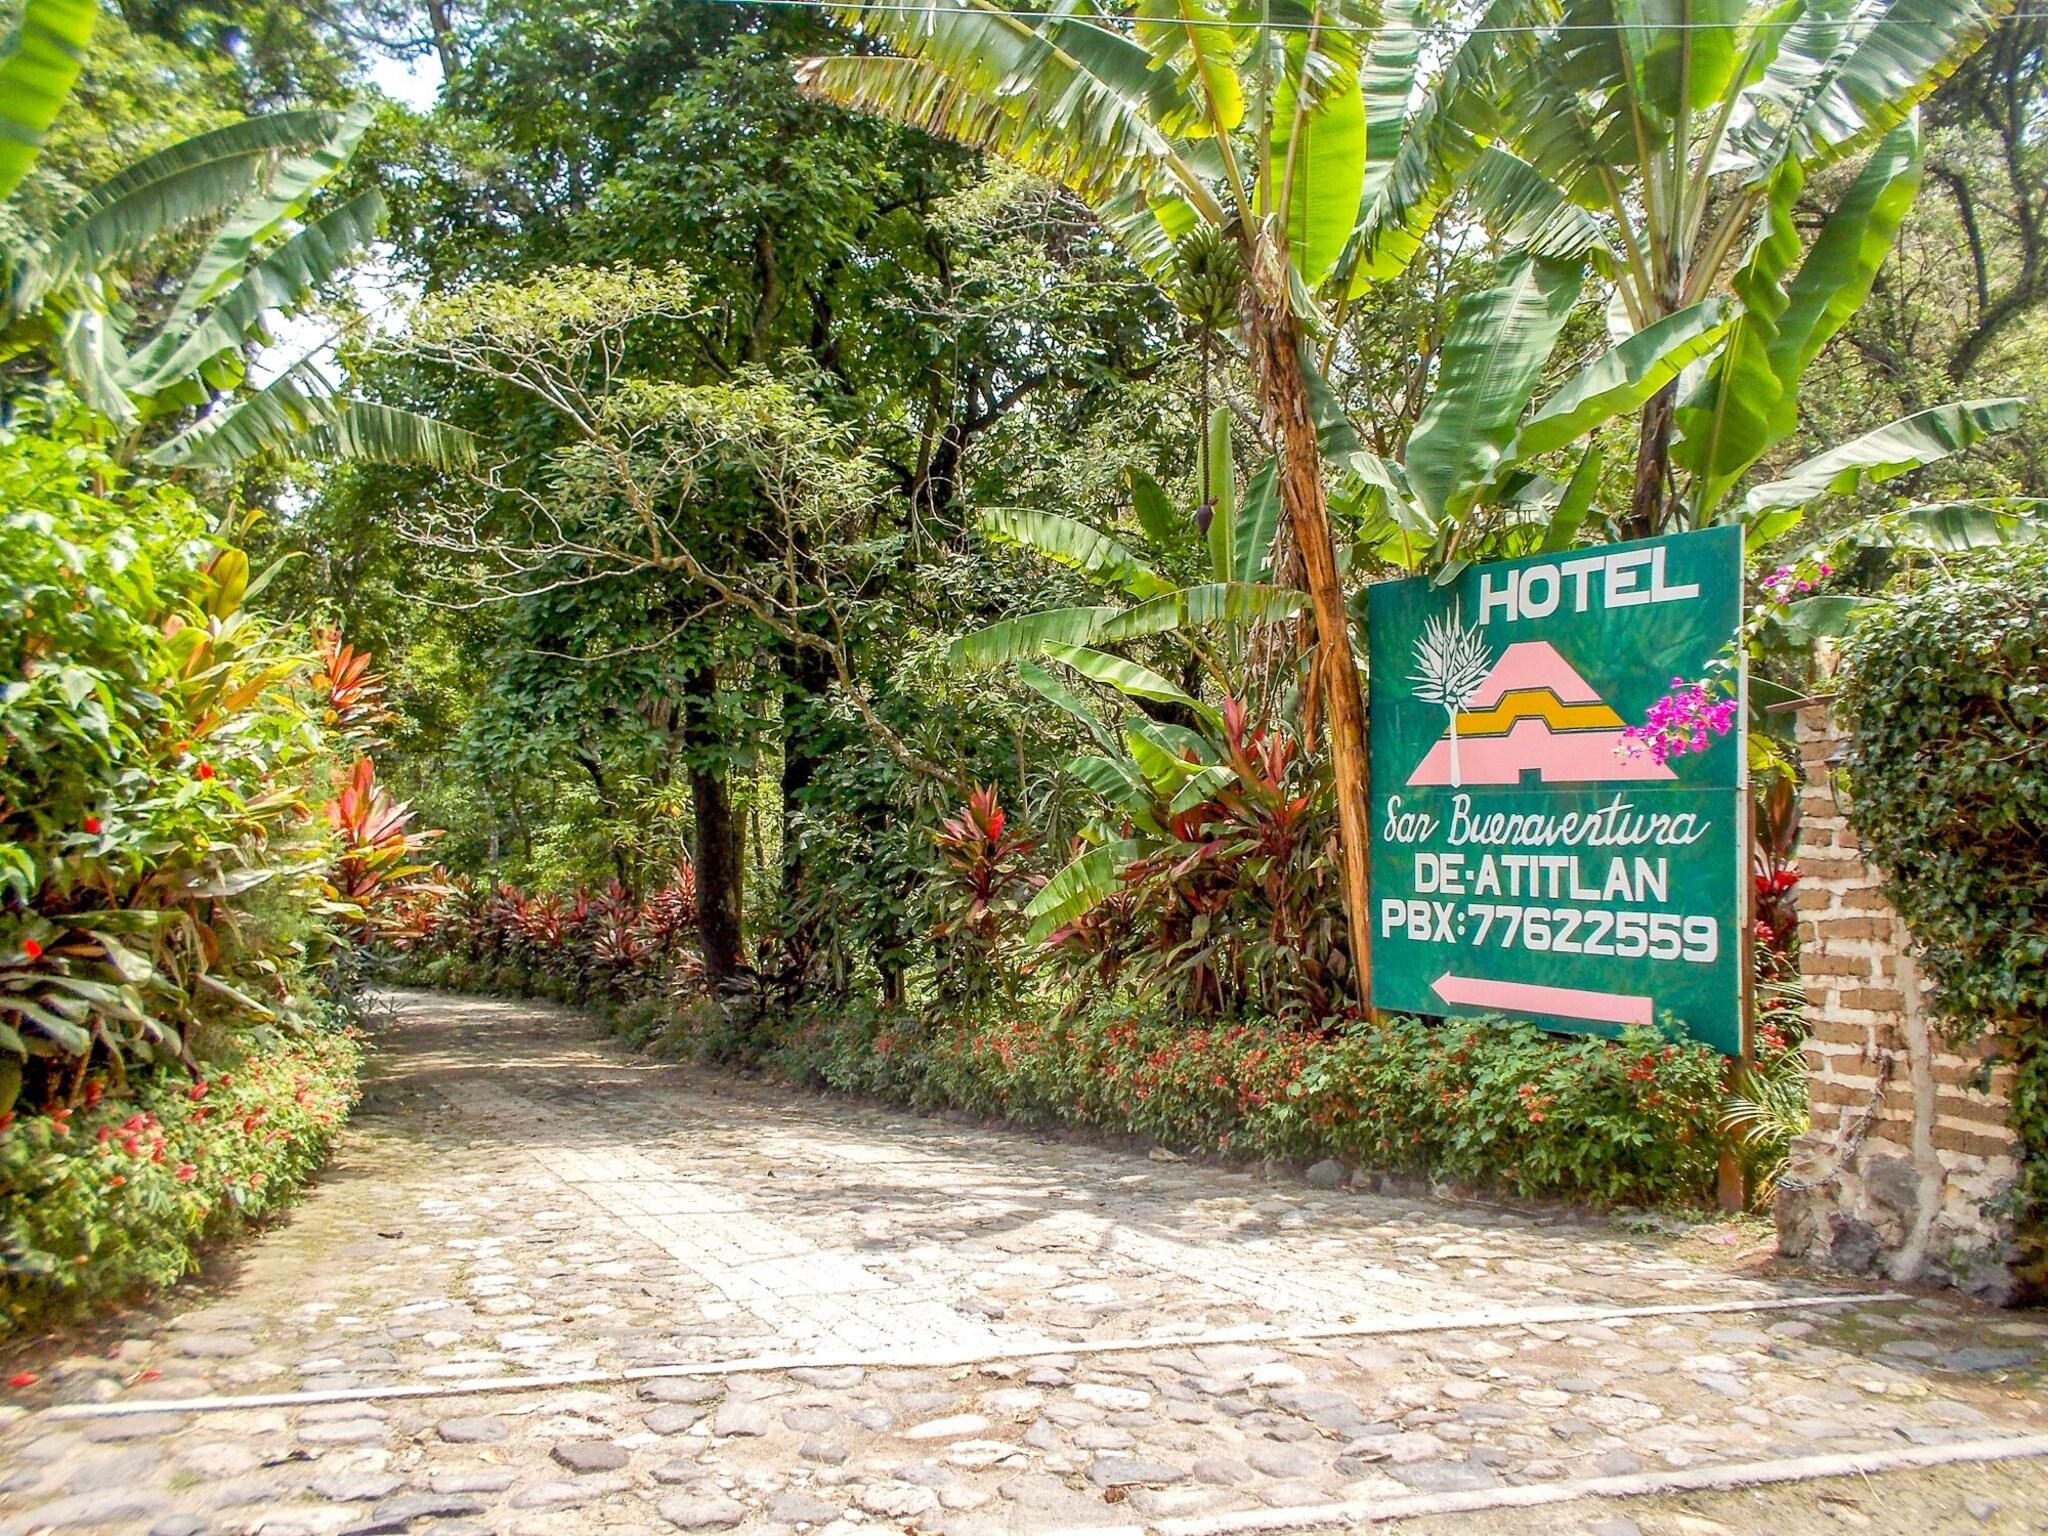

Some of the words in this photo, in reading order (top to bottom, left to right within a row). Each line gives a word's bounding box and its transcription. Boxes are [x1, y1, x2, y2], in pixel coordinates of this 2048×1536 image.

[1479, 546, 1700, 625] HOTEL
[1383, 795, 1440, 843] San
[1447, 792, 1711, 847] Buenaventura
